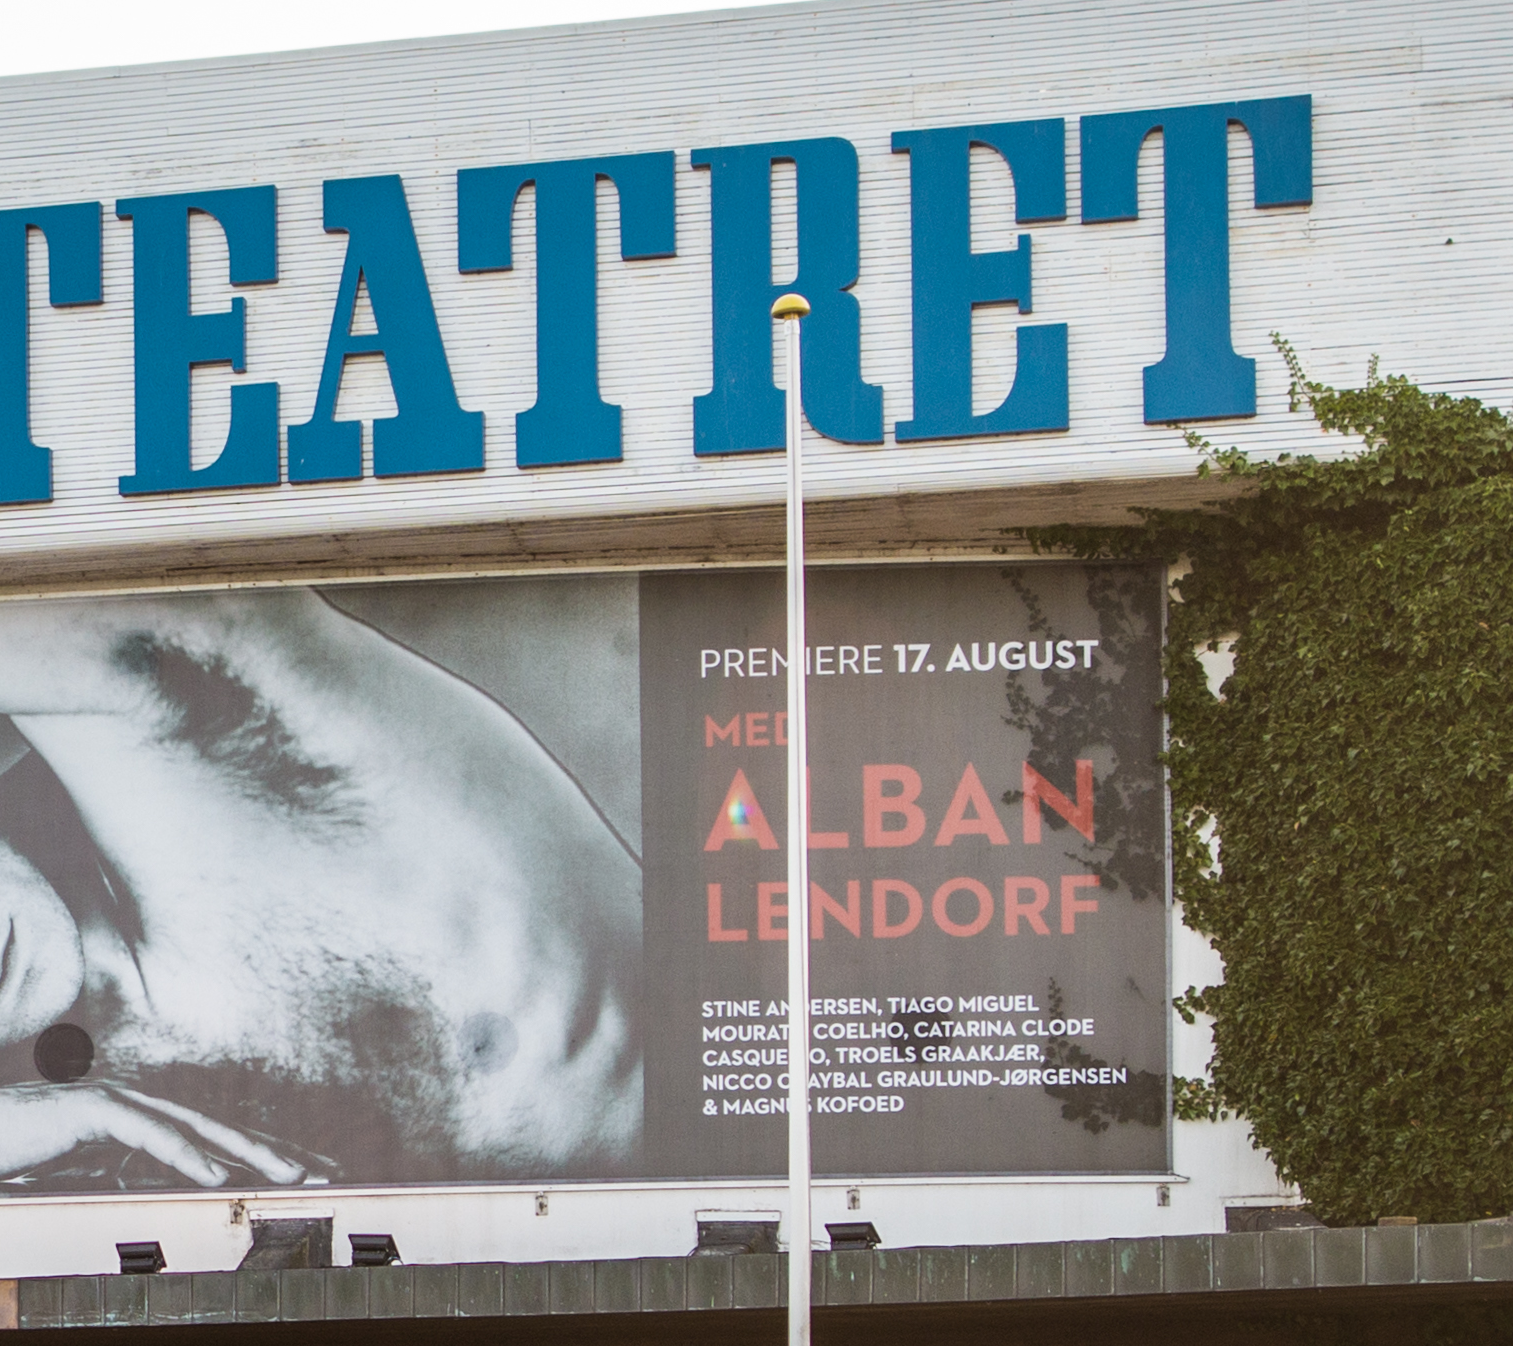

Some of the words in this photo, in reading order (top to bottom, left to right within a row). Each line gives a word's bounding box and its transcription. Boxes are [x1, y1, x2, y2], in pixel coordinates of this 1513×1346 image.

[893, 644, 936, 673] 17.
[945, 639, 1100, 671] AUGUST
[703, 759, 1095, 851] ALBAN
[707, 874, 1101, 942] LENDORF
[702, 1000, 760, 1017] STINE
[765, 997, 883, 1016] ANERSEN,
[887, 996, 953, 1014] TIAGO
[959, 995, 1040, 1013] MIGUEL
[703, 1024, 790, 1042] MOURAT
[813, 1022, 909, 1040] COELHO,
[914, 1020, 1016, 1038] CATARINA
[1021, 1018, 1095, 1036] CLODE
[702, 1047, 831, 1066] CASQUEO,
[835, 1046, 916, 1064] TROELS
[921, 1044, 1045, 1063] GRAAKJÆR,
[702, 1073, 772, 1091] NICCO
[877, 1067, 1127, 1087] GRAULUND-JØRGENSEN
[702, 1098, 718, 1116] &
[817, 1095, 905, 1113] KOFOED
